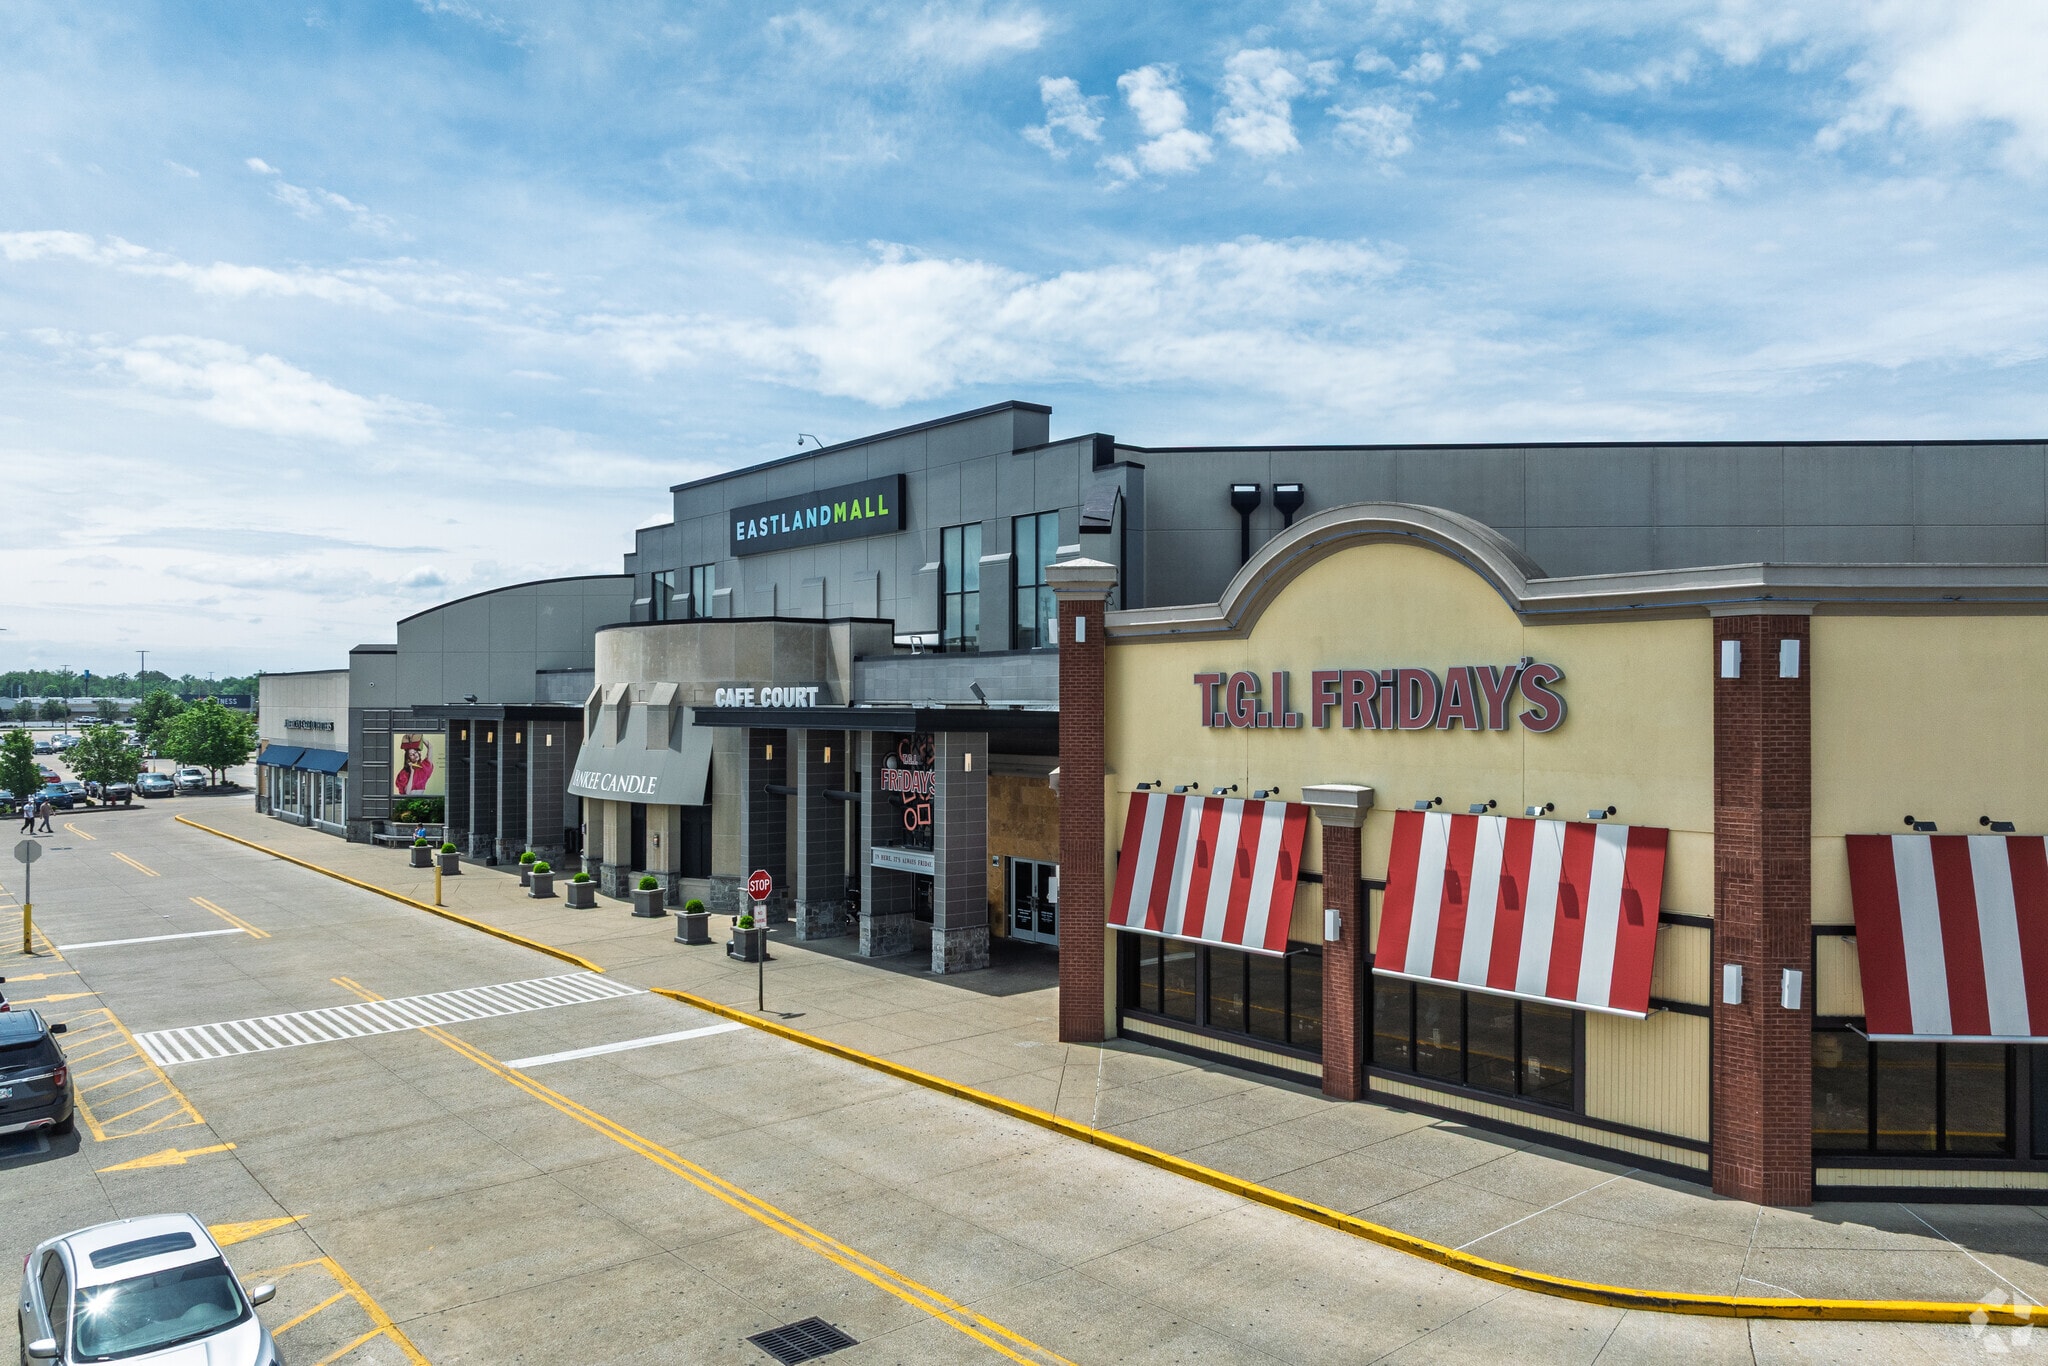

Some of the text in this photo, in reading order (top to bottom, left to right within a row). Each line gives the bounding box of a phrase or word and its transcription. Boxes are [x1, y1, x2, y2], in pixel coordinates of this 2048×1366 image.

[715, 687, 819, 708] CAFE COURT
[1194, 671, 1303, 729] T.G.I.
[573, 769, 658, 794] YANKEE CANDLE
[750, 879, 770, 892] STOP
